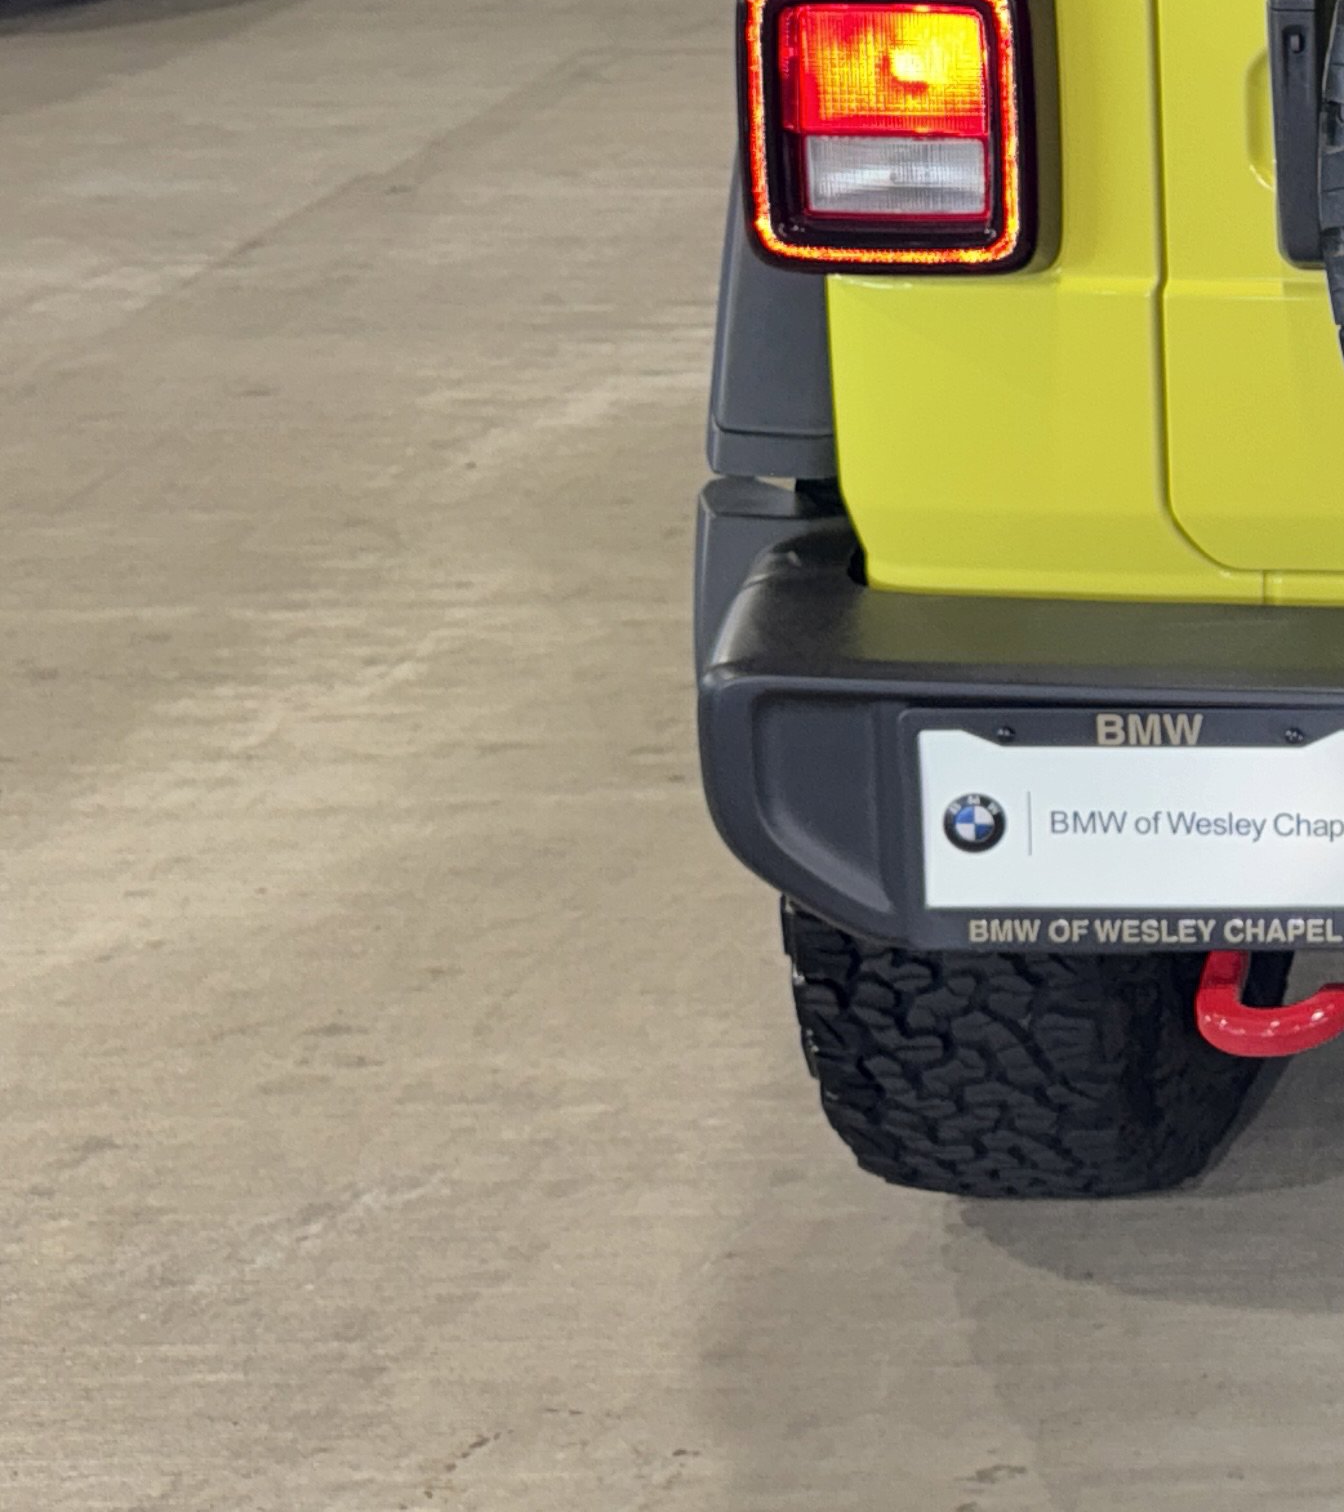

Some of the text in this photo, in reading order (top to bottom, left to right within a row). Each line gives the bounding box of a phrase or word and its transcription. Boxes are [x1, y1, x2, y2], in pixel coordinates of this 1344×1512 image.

[1095, 713, 1204, 746] BMW
[1049, 810, 1126, 835] BMW
[1134, 810, 1162, 836] of
[1168, 811, 1267, 841] Wesley
[968, 917, 1343, 944] BMW OF WESLEY CHAPEL
